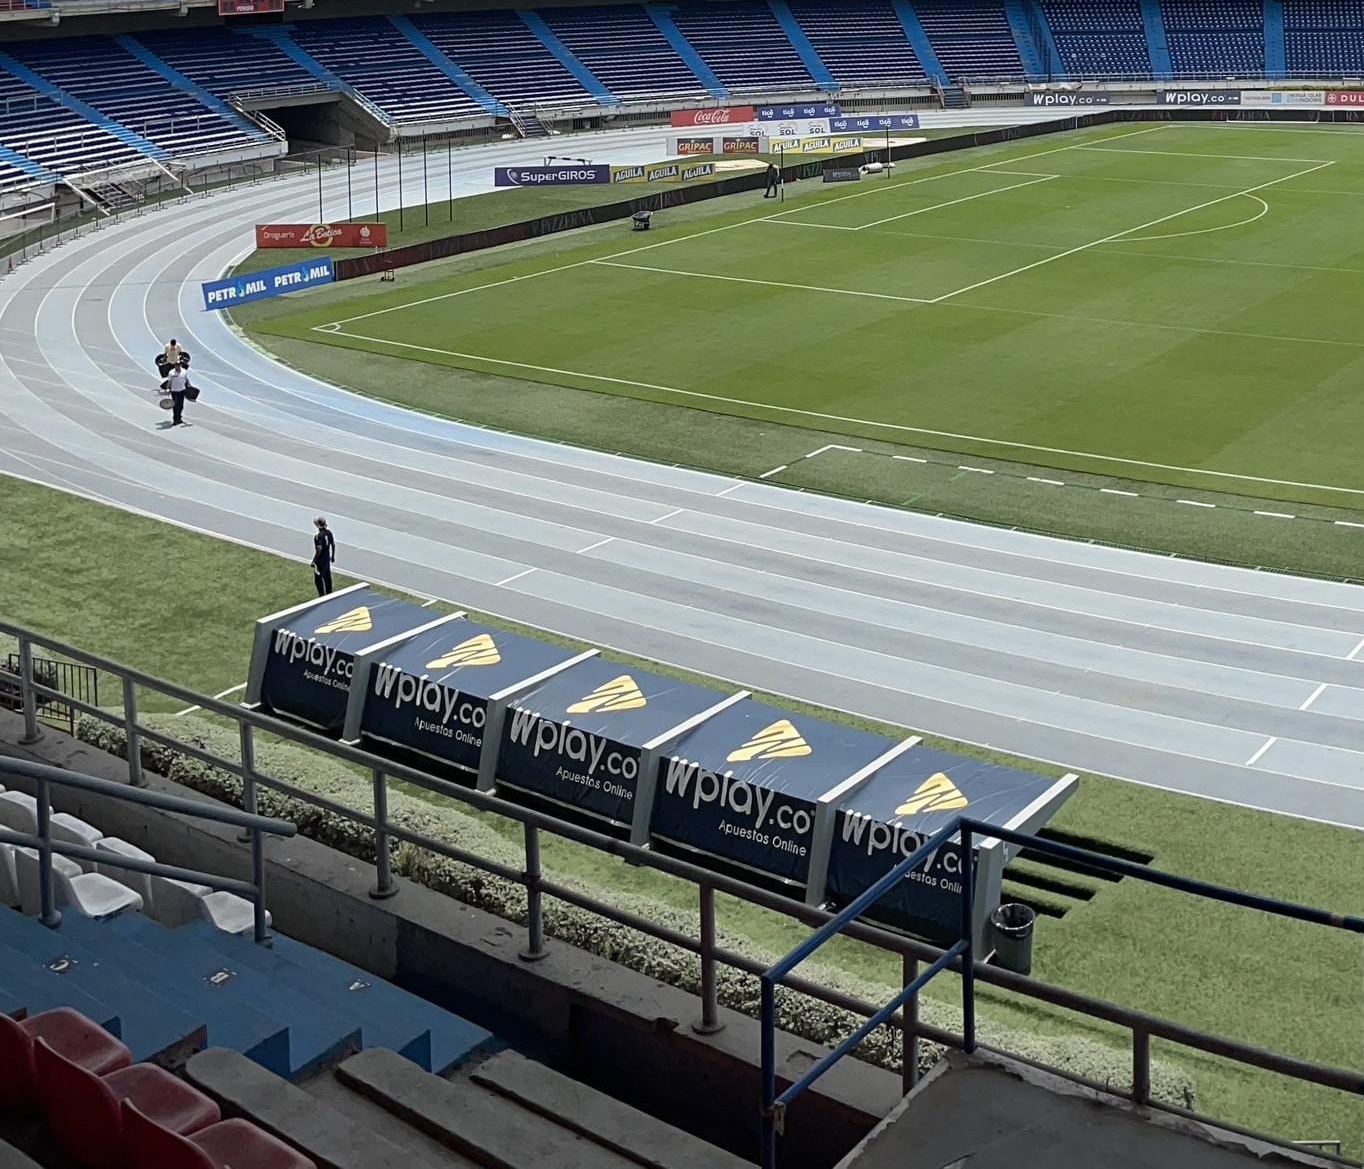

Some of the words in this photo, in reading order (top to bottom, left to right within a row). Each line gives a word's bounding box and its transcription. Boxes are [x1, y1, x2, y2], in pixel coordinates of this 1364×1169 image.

[678, 139, 711, 151] GRIPAC
[723, 138, 757, 150] GRIPAC
[521, 170, 596, 182] SuperGIROS
[300, 230, 315, 242] La
[315, 226, 343, 239] Botica
[455, 729, 482, 748] Online
[602, 779, 633, 801] Online
[771, 832, 806, 857] Online
